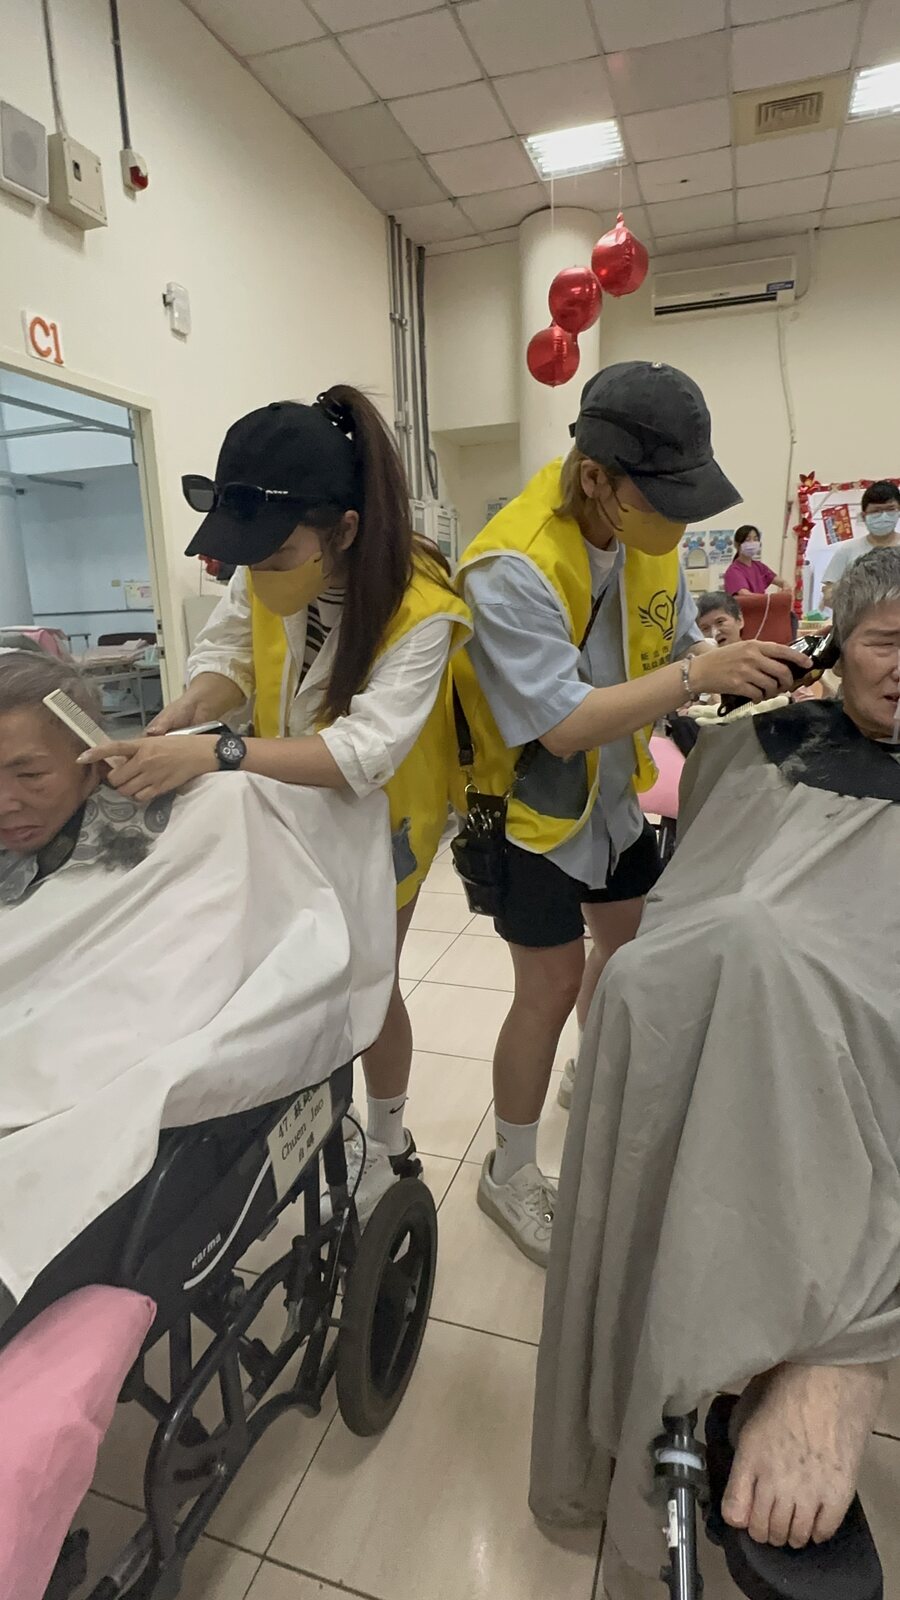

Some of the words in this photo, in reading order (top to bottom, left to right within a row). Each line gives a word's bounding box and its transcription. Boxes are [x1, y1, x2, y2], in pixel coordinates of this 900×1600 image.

[29, 316, 64, 365] C1
[281, 1123, 307, 1161] Chuen
[191, 1232, 222, 1270] karma
